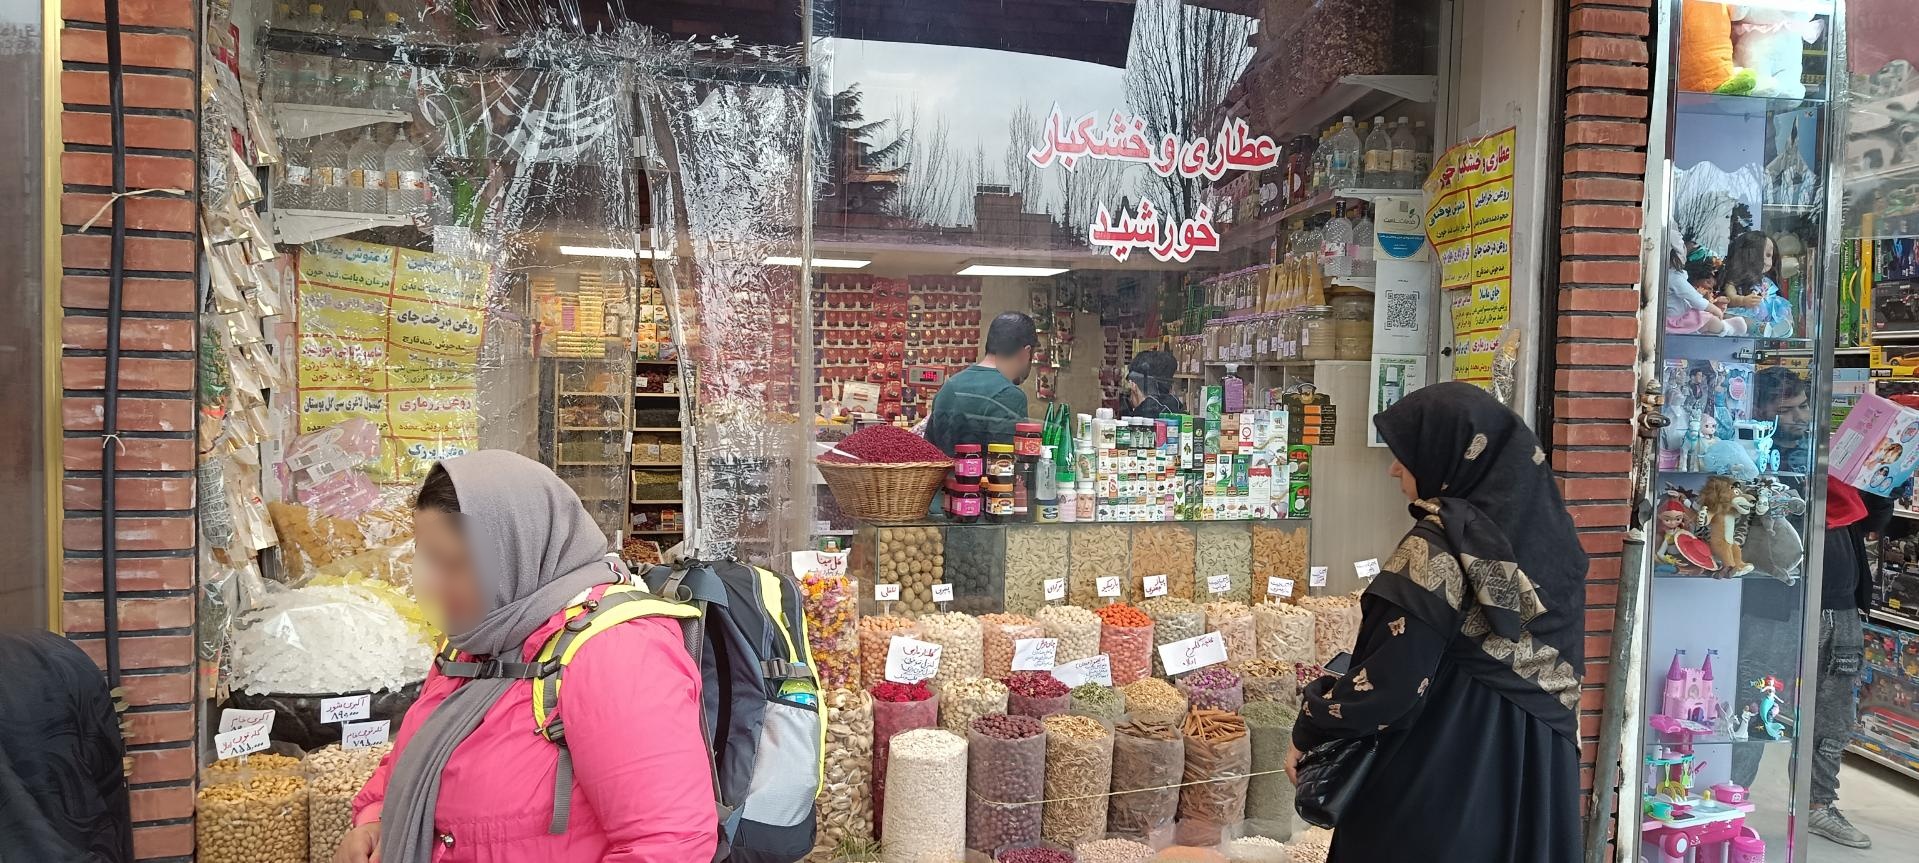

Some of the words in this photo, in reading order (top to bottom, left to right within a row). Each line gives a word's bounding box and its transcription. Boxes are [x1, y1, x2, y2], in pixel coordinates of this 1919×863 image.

[1027, 100, 1155, 173] خشکبار
[1150, 133, 1178, 177] و
[1178, 116, 1282, 181] عطاری
[1486, 144, 1510, 172] عطاری
[1493, 190, 1509, 202] روغن
[1089, 196, 1220, 263] خورشید
[365, 278, 390, 288] درمان
[397, 310, 420, 326] چای
[421, 313, 452, 330] درخت
[452, 317, 478, 334] روغن
[816, 551, 832, 567] مینا
[830, 555, 843, 571] گل
[326, 701, 343, 713] شور
